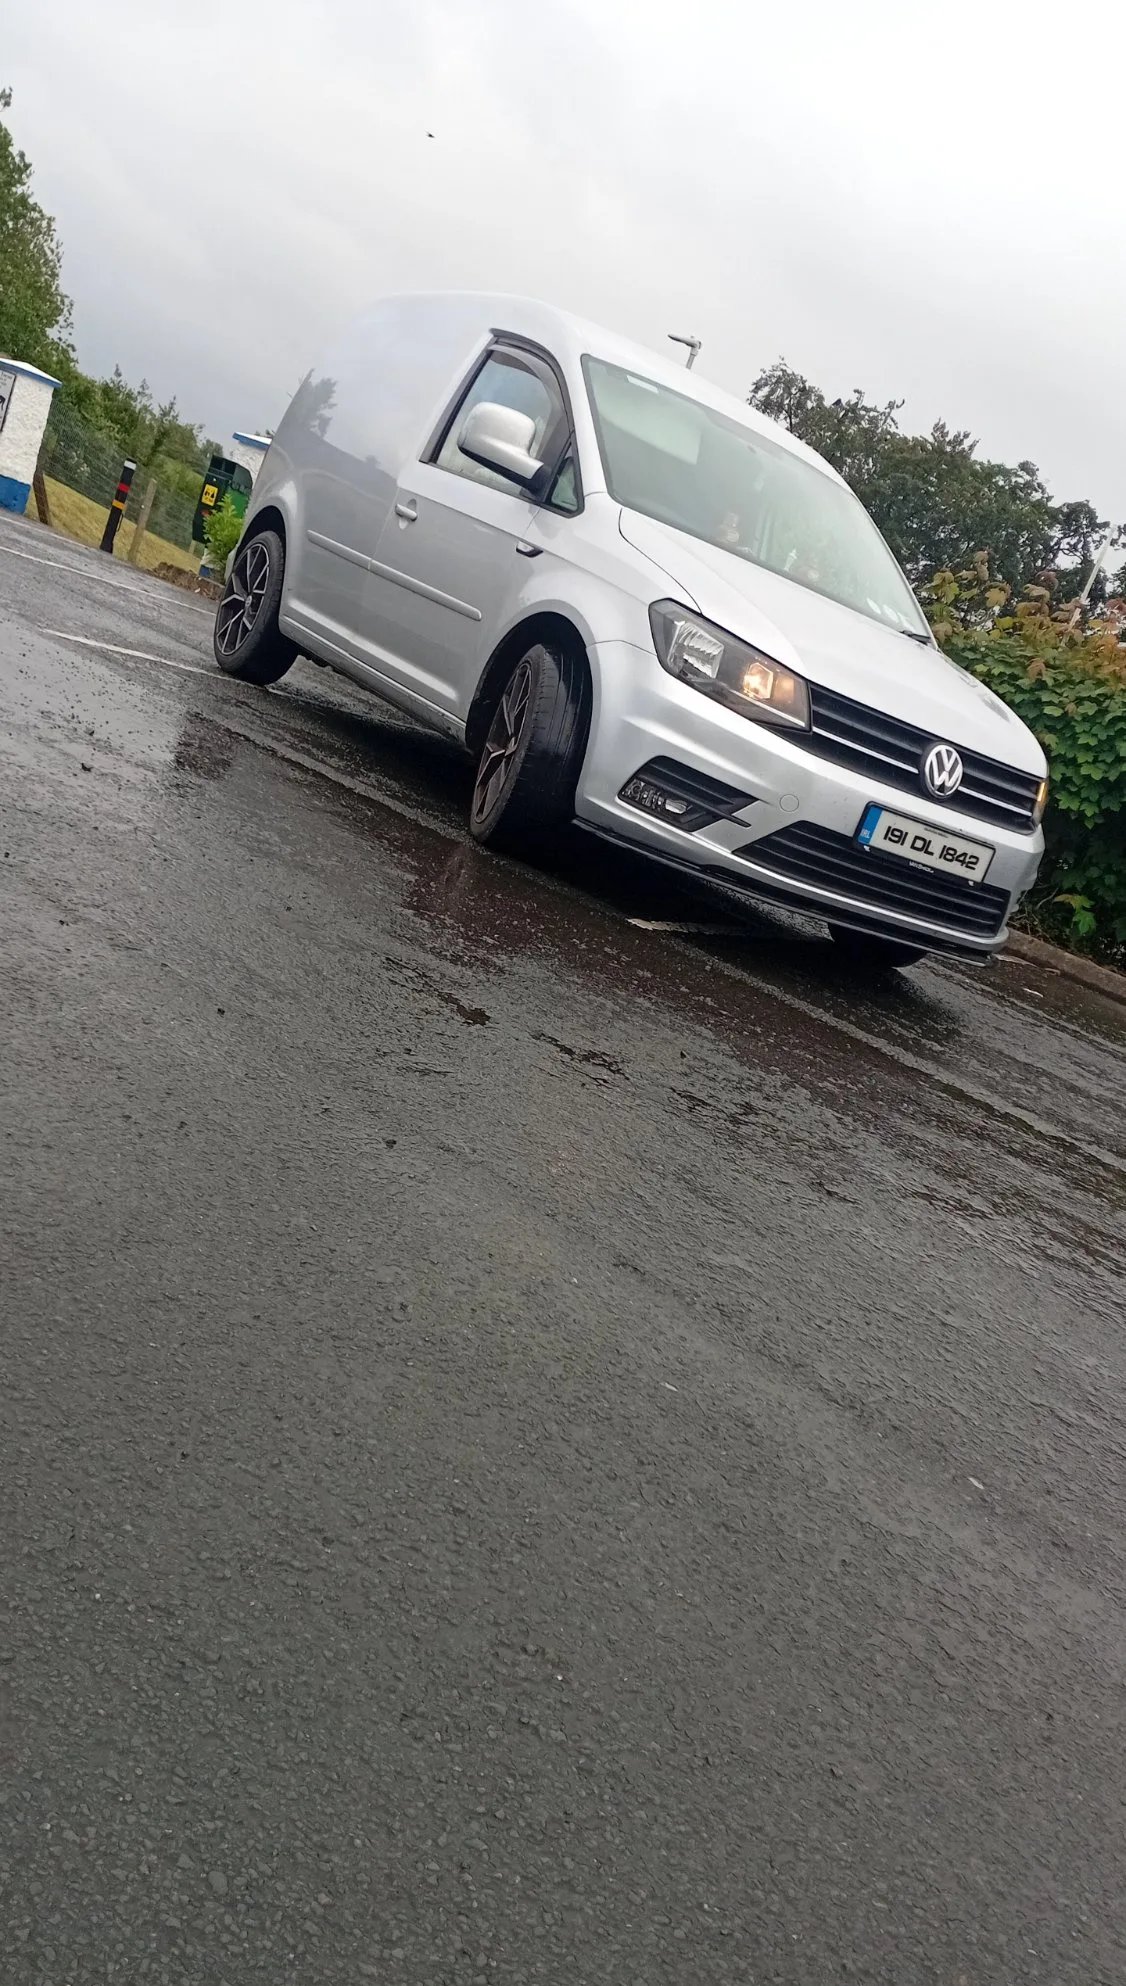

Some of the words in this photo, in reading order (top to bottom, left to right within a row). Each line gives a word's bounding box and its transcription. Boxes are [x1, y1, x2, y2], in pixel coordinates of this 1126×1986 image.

[925, 745, 963, 796] VW
[860, 829, 870, 839] IRL
[883, 826, 908, 845] 191
[910, 835, 934, 856] DL
[938, 845, 979, 870] 1842
